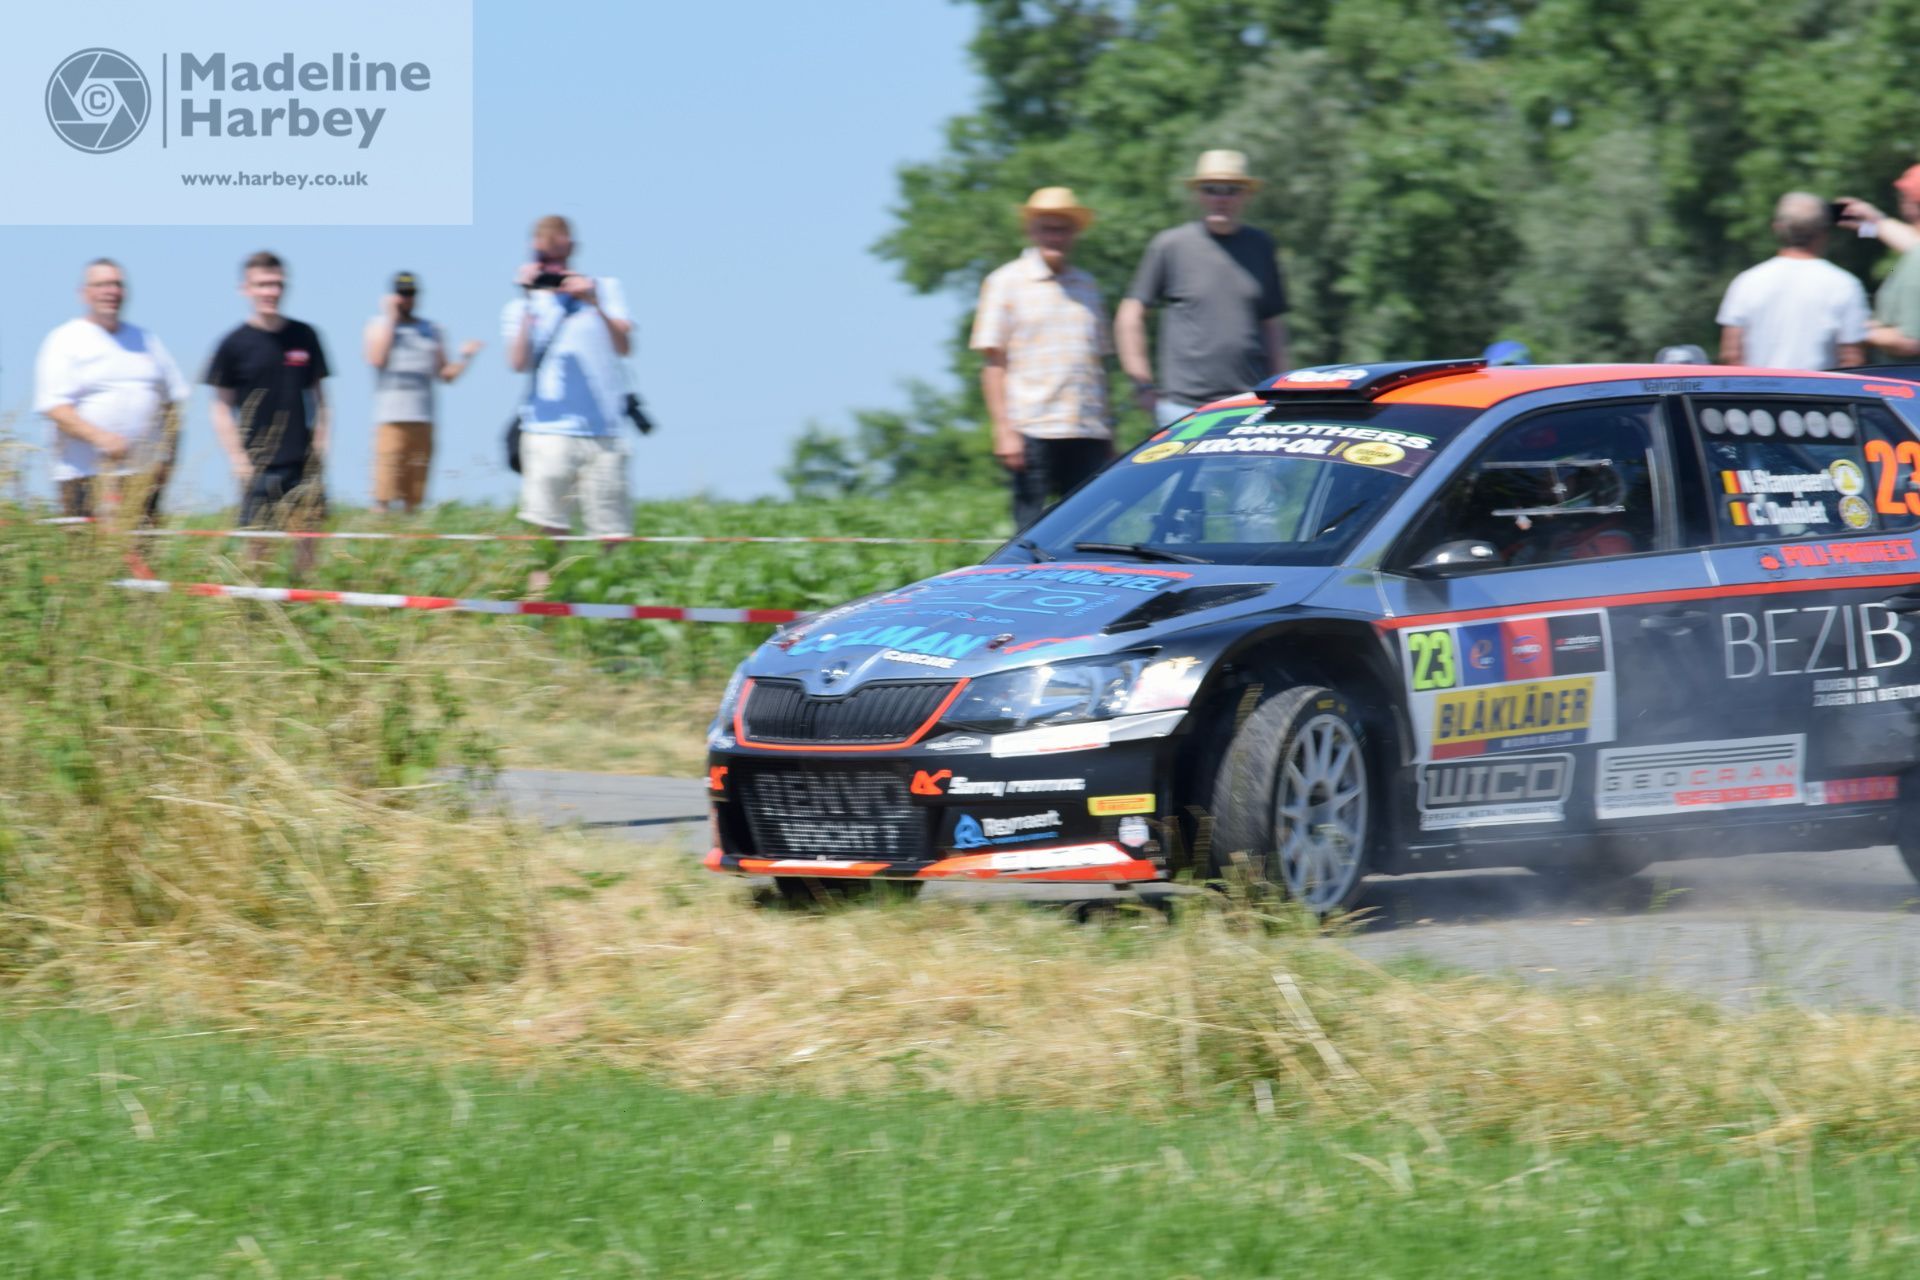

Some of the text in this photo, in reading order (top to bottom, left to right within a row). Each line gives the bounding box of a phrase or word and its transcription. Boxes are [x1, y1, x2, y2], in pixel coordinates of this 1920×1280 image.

[1189, 436, 1334, 455] KROON-OIL
[1227, 424, 1432, 450] BROTHERS
[1408, 631, 1457, 690] 23
[1440, 685, 1589, 739] BLÅKLÄDER
[1427, 761, 1567, 805] WICO
